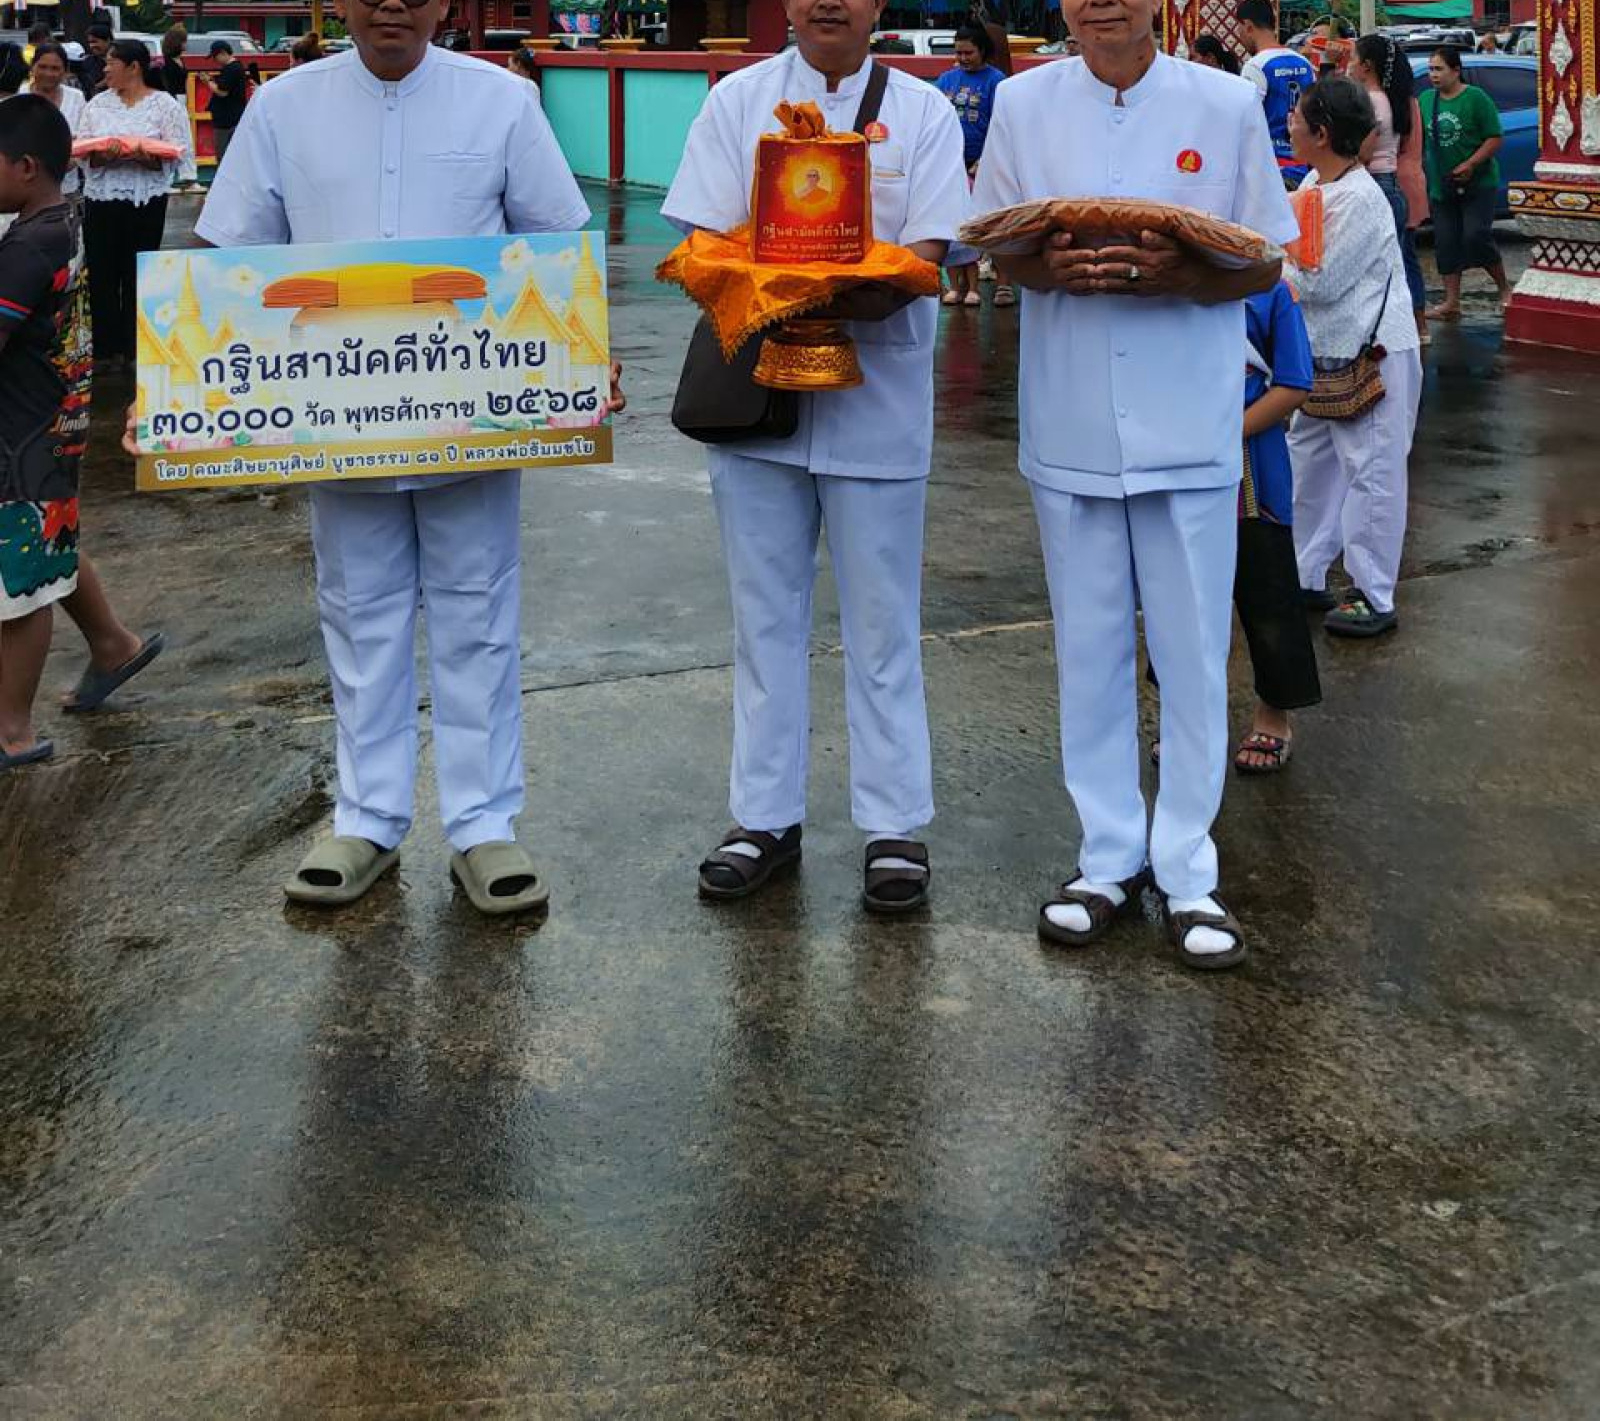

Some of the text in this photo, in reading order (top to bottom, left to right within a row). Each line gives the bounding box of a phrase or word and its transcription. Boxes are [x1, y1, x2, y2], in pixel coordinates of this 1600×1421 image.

[202, 321, 546, 395] กฐินสามัคคีทั่วไทย
[152, 386, 598, 438] ๓๐,๐๐๐ วัด พุทธศักราช ๒๕๖๘
[157, 460, 187, 479] โดย
[332, 452, 409, 474] บูชาธรรม
[446, 444, 458, 462] ปี
